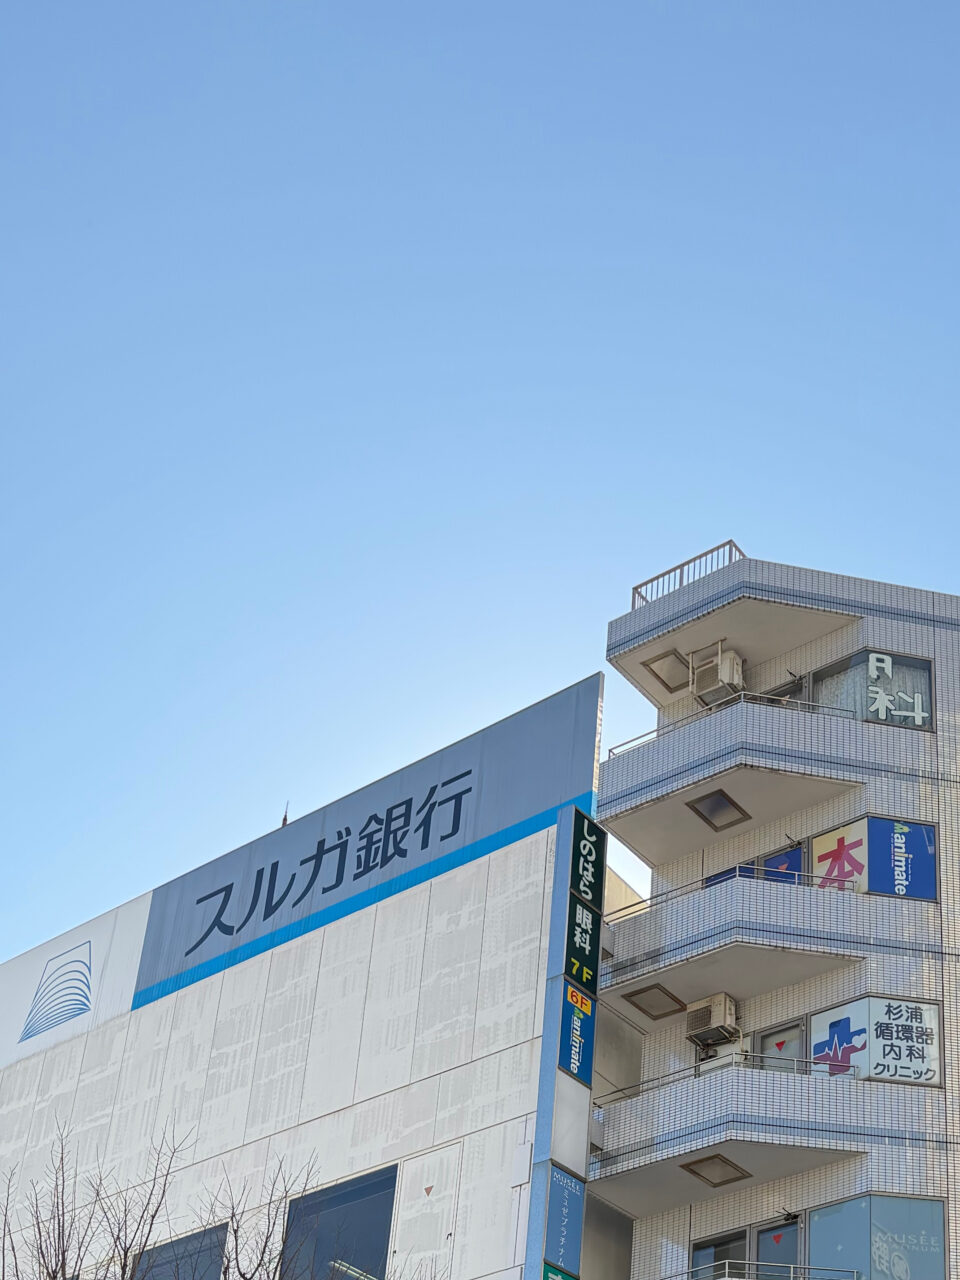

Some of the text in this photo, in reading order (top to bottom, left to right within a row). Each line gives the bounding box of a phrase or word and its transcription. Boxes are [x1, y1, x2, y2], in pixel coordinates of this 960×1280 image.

[184, 769, 473, 958] スルガ銀行
[817, 836, 865, 892] 本
[893, 833, 914, 896] animate
[574, 819, 596, 955] しのはら 眼科
[570, 957, 593, 983] 7F
[570, 990, 588, 1009] 6F
[885, 1003, 923, 1024] 杉浦
[569, 1017, 583, 1074] animate
[874, 1021, 935, 1045] 循環器
[883, 1042, 926, 1064] 内科
[873, 1062, 937, 1081] クリニック
[558, 1190, 569, 1268] ミュゼプラチナム
